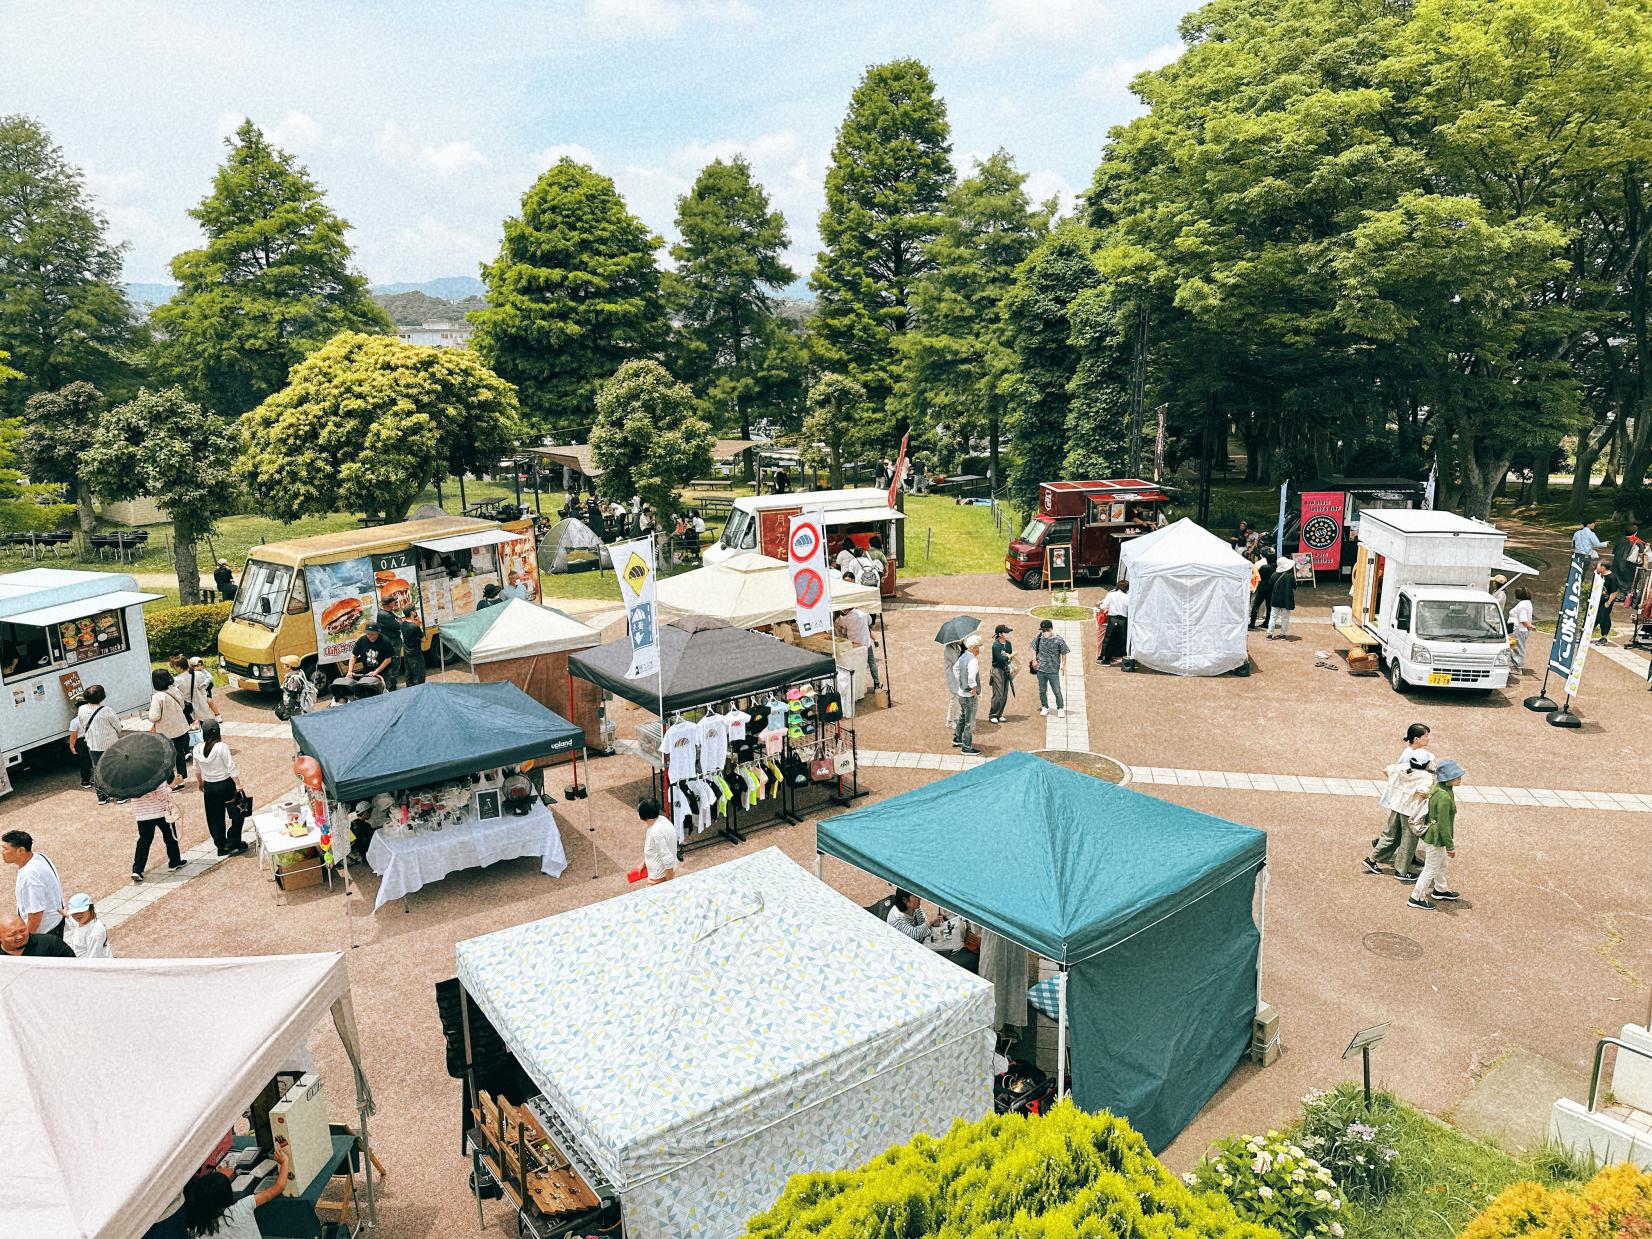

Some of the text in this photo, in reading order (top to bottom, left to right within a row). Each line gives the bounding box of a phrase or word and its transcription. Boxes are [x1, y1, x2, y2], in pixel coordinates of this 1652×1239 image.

[380, 556, 407, 570] OAZ
[67, 686, 83, 697] OPEN
[551, 739, 573, 750] upland
